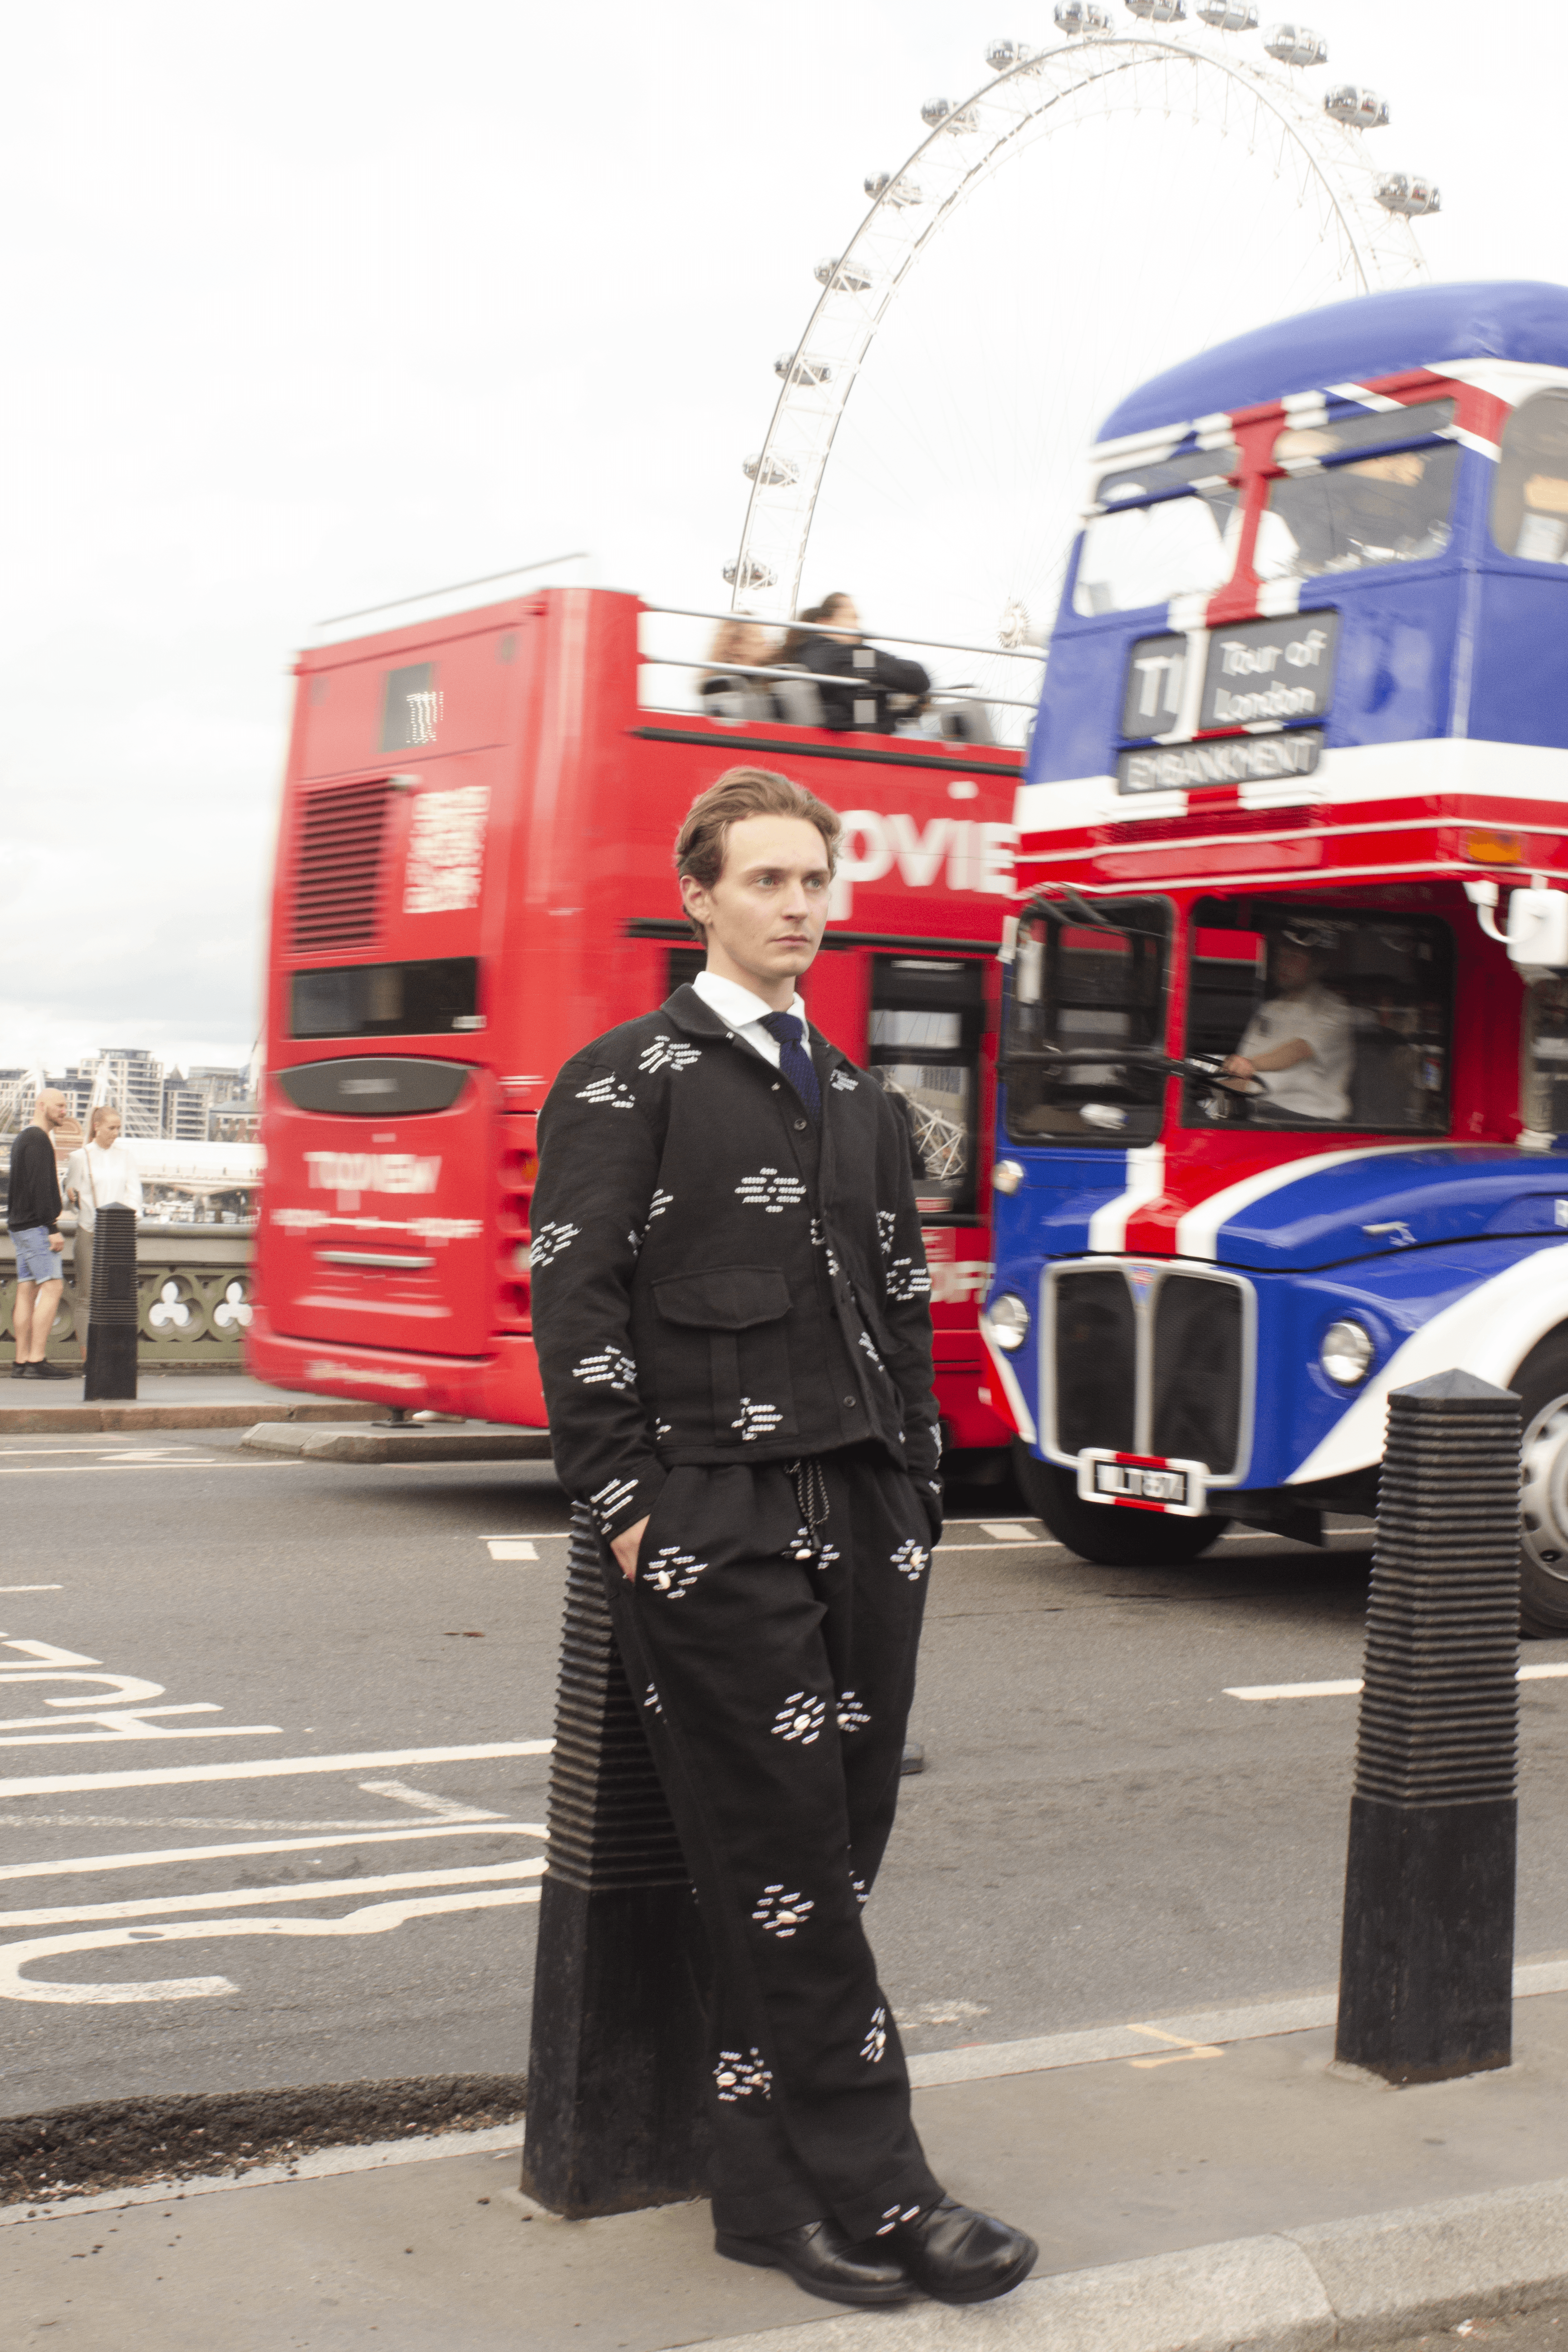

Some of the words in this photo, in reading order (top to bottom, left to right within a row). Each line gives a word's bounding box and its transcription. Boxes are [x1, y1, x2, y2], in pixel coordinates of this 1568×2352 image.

[1220, 641, 1283, 676] Tour
[1284, 629, 1328, 667] of
[1213, 681, 1315, 722] London
